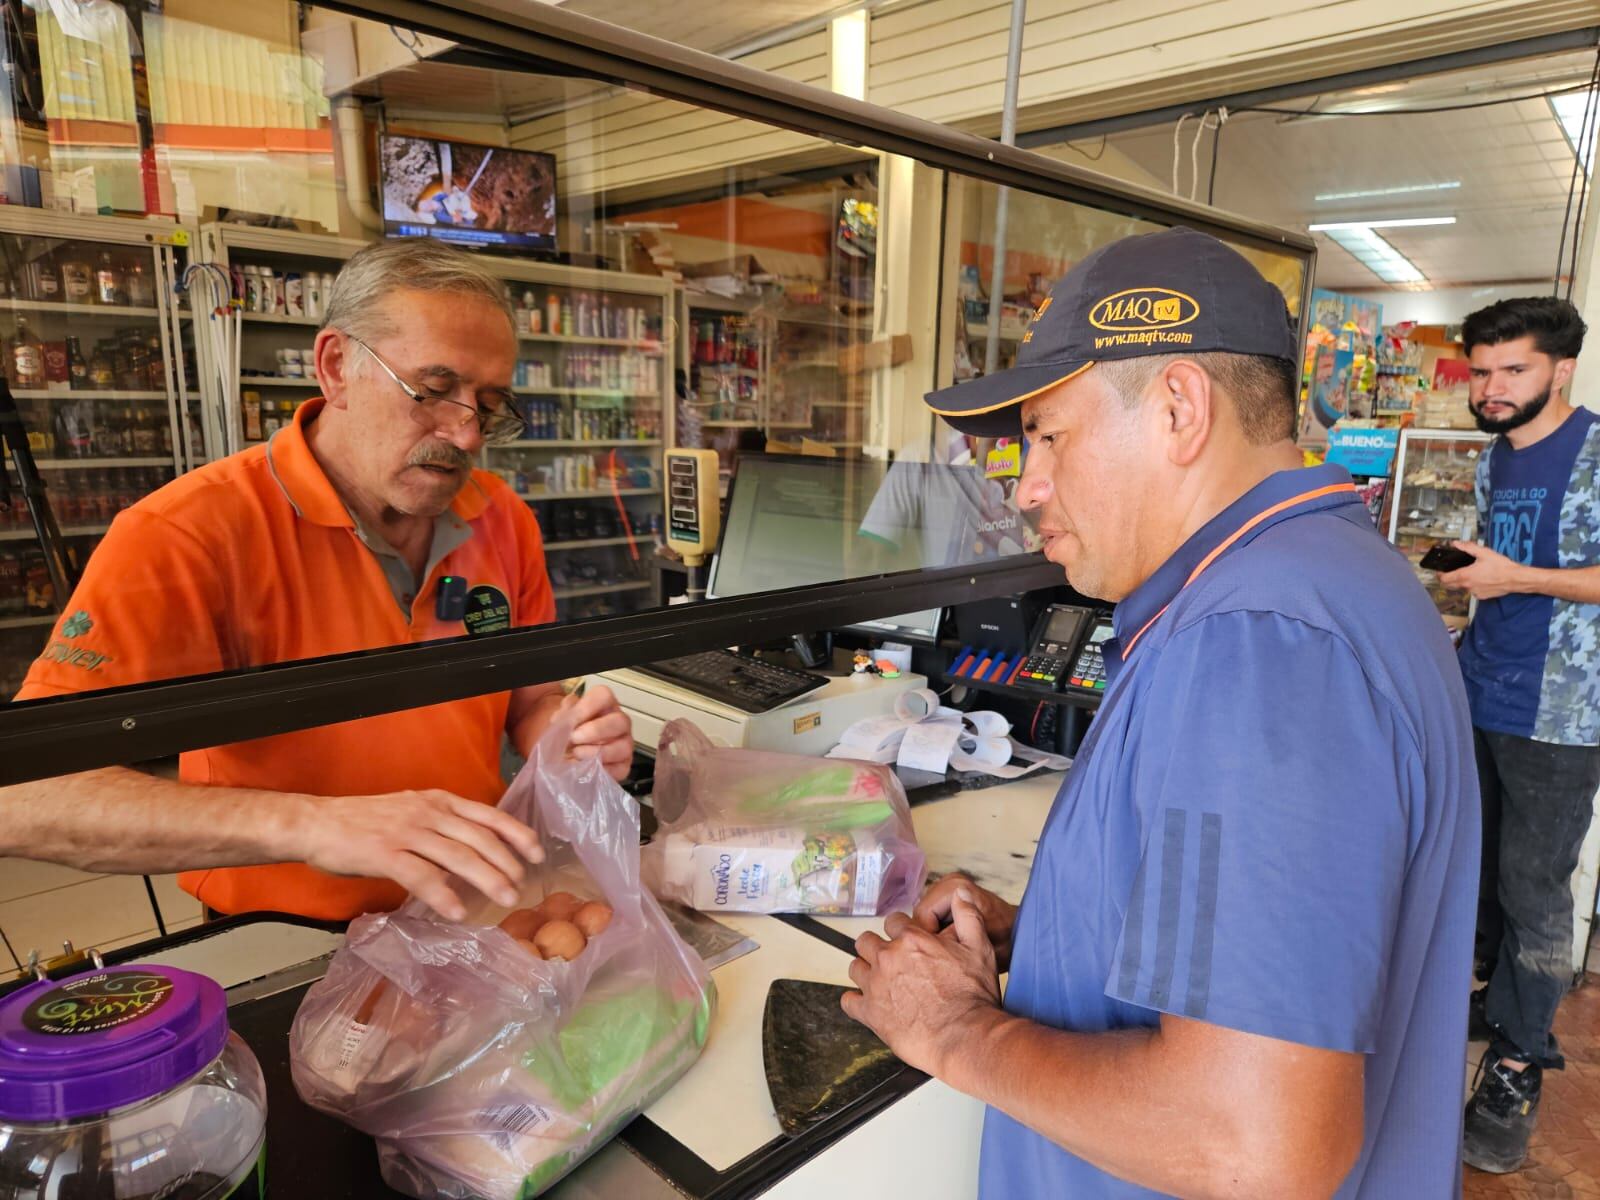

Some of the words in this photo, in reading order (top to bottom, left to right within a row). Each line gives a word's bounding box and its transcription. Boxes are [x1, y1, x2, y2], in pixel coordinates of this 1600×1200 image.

[1100, 297, 1159, 324] MAQ
[1094, 329, 1193, 349] www.maqtv.com
[1341, 435, 1385, 449] BUENO
[1529, 487, 1548, 500] GO
[714, 853, 731, 905] CORONADO
